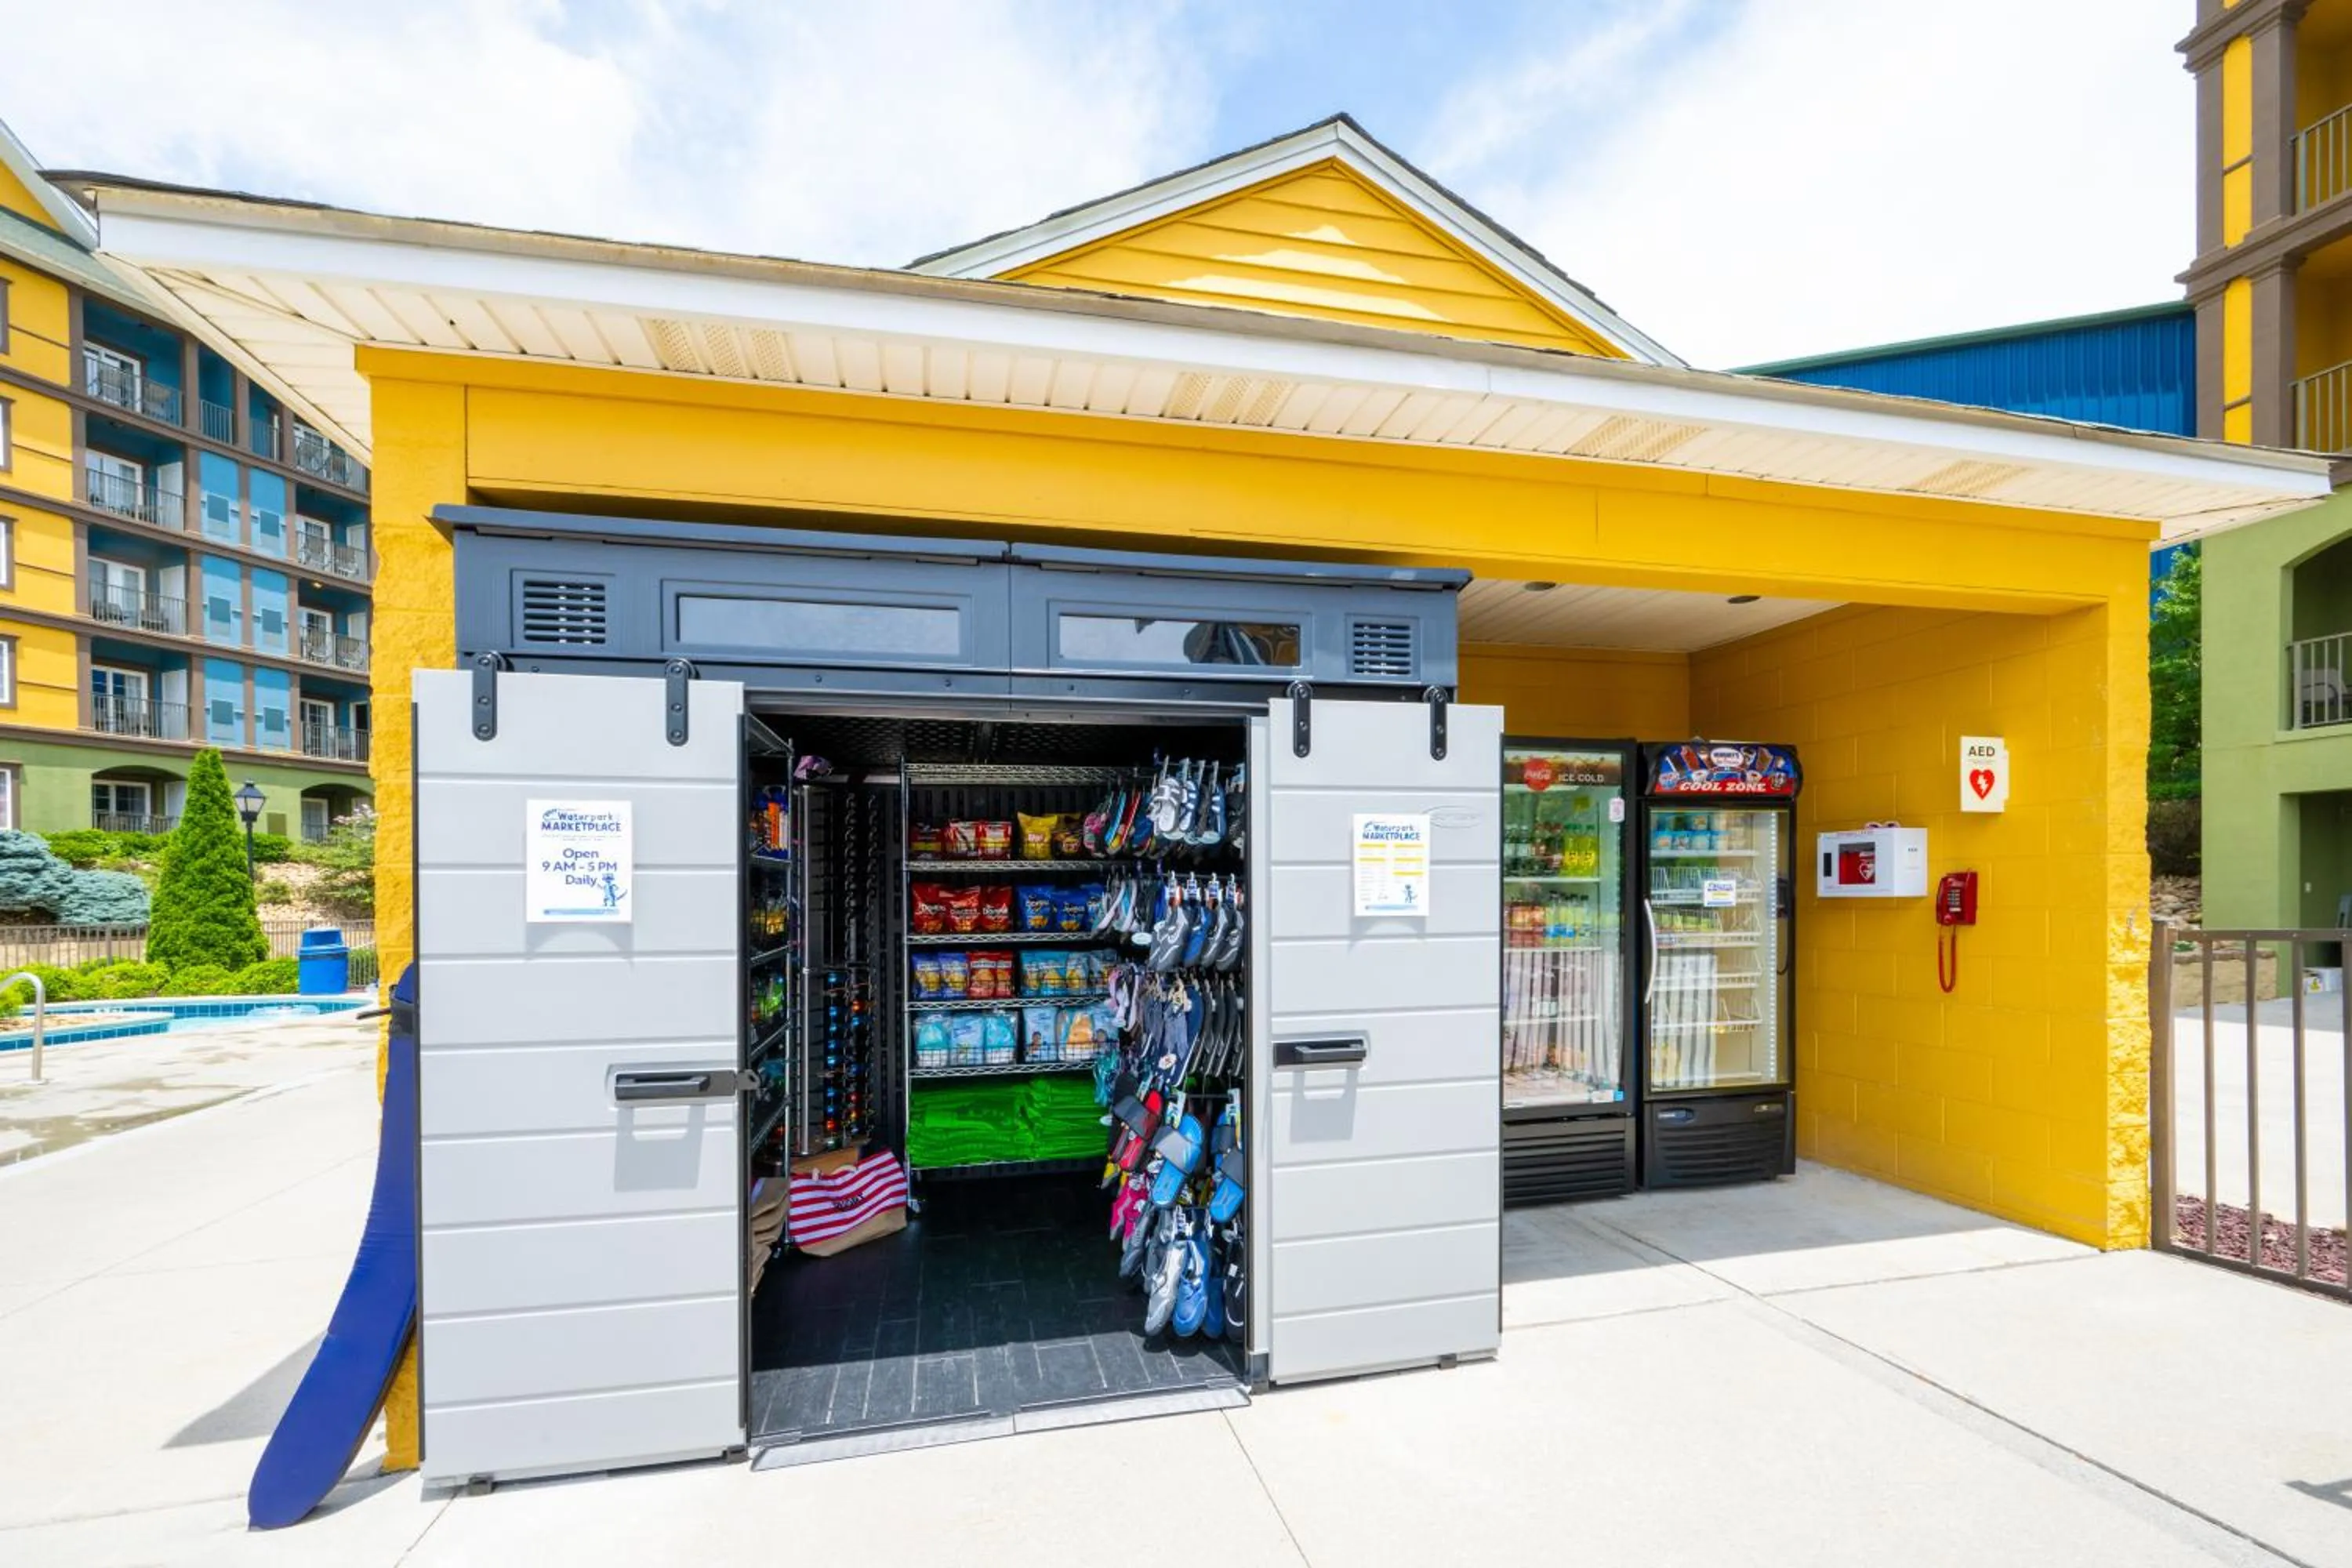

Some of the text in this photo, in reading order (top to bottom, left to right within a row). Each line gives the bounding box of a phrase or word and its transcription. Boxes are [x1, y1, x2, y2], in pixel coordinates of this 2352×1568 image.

[1968, 746, 1996, 757] AED
[1557, 774, 1605, 783] ICE COLD
[1679, 782, 1766, 792] COOL ZONE
[557, 811, 613, 821] Waterpark
[541, 821, 622, 832] MARKETPLACE
[1362, 832, 1421, 840] MARKETPLACE
[562, 848, 600, 861] Open
[542, 861, 550, 872] 9
[553, 861, 576, 872] AM
[587, 862, 595, 872] 5
[598, 861, 618, 872] PM
[565, 874, 597, 887] Daily
